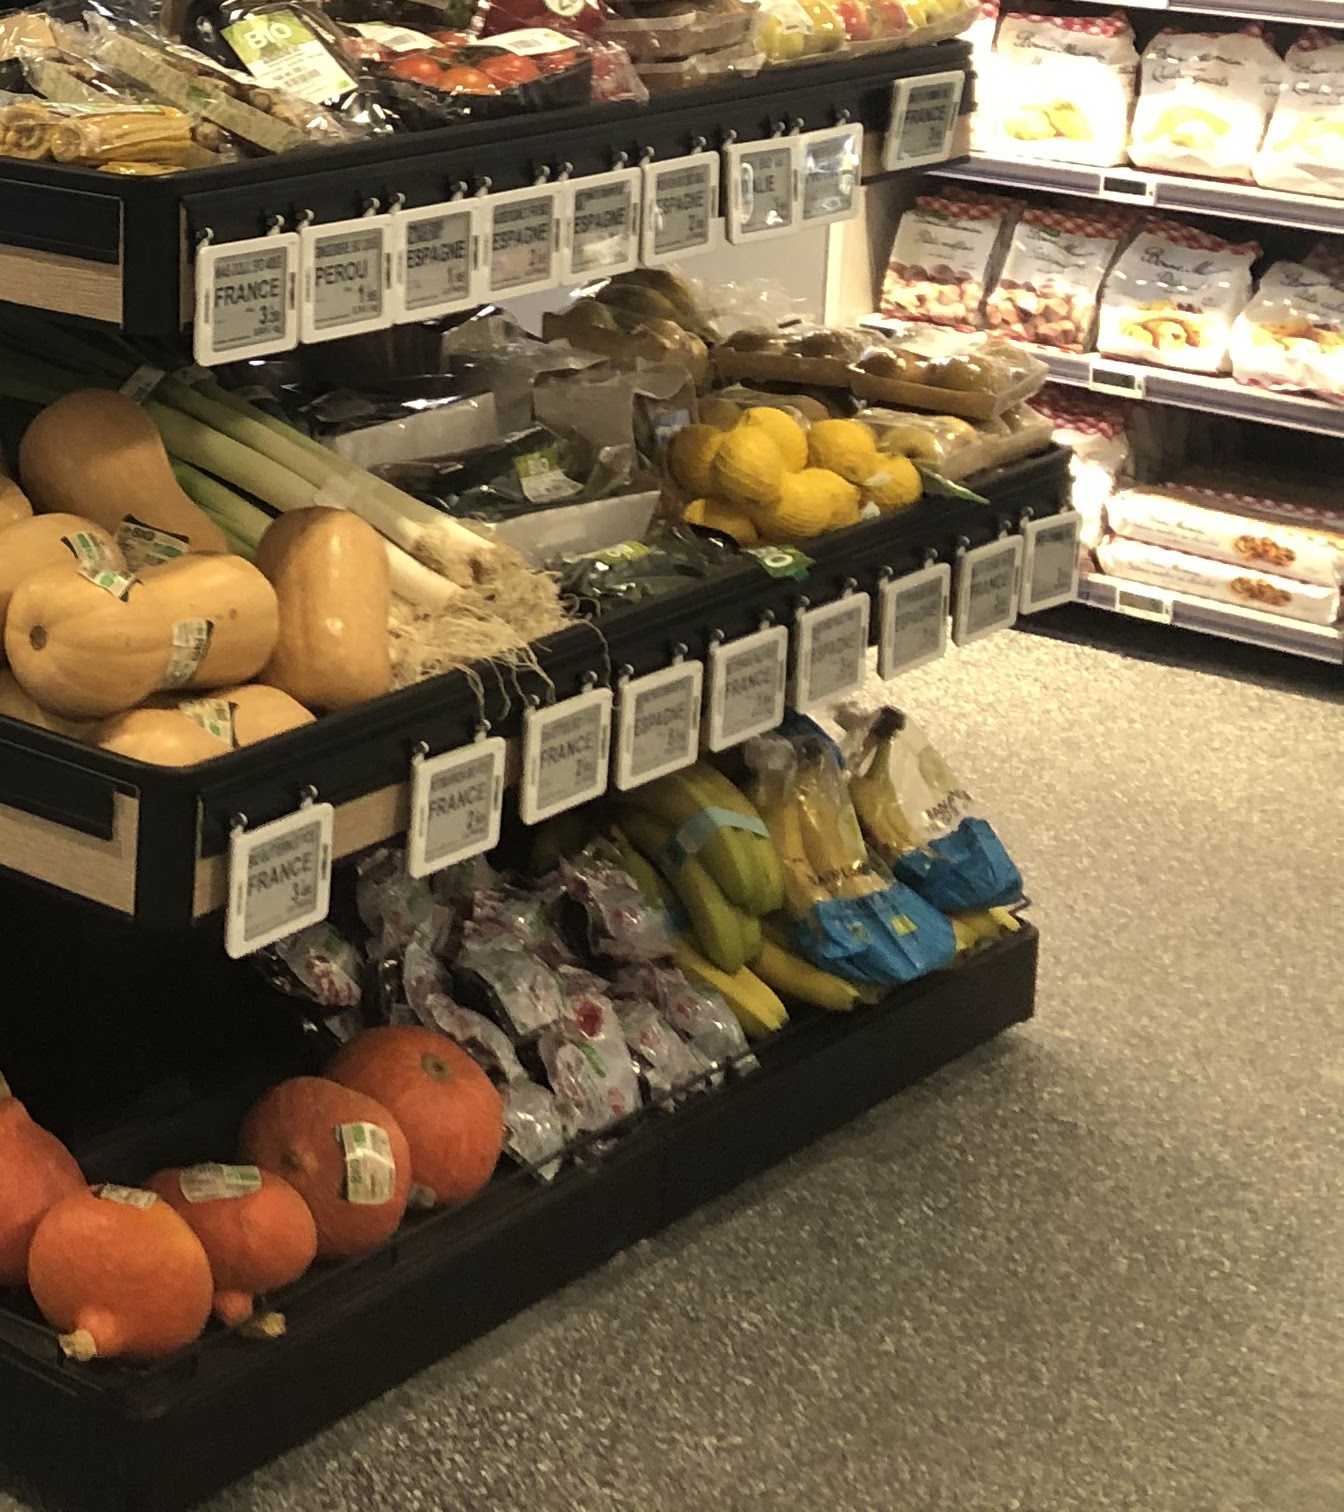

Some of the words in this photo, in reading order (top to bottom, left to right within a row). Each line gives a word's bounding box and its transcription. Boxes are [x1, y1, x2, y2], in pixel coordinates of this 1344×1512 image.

[493, 223, 548, 251] ESPAGNE
[407, 240, 466, 268] ESPAGNE
[315, 260, 368, 287] PEROU
[215, 278, 279, 308] FRANCE
[431, 781, 485, 819] FRANCE
[249, 852, 311, 896] FRANCE
